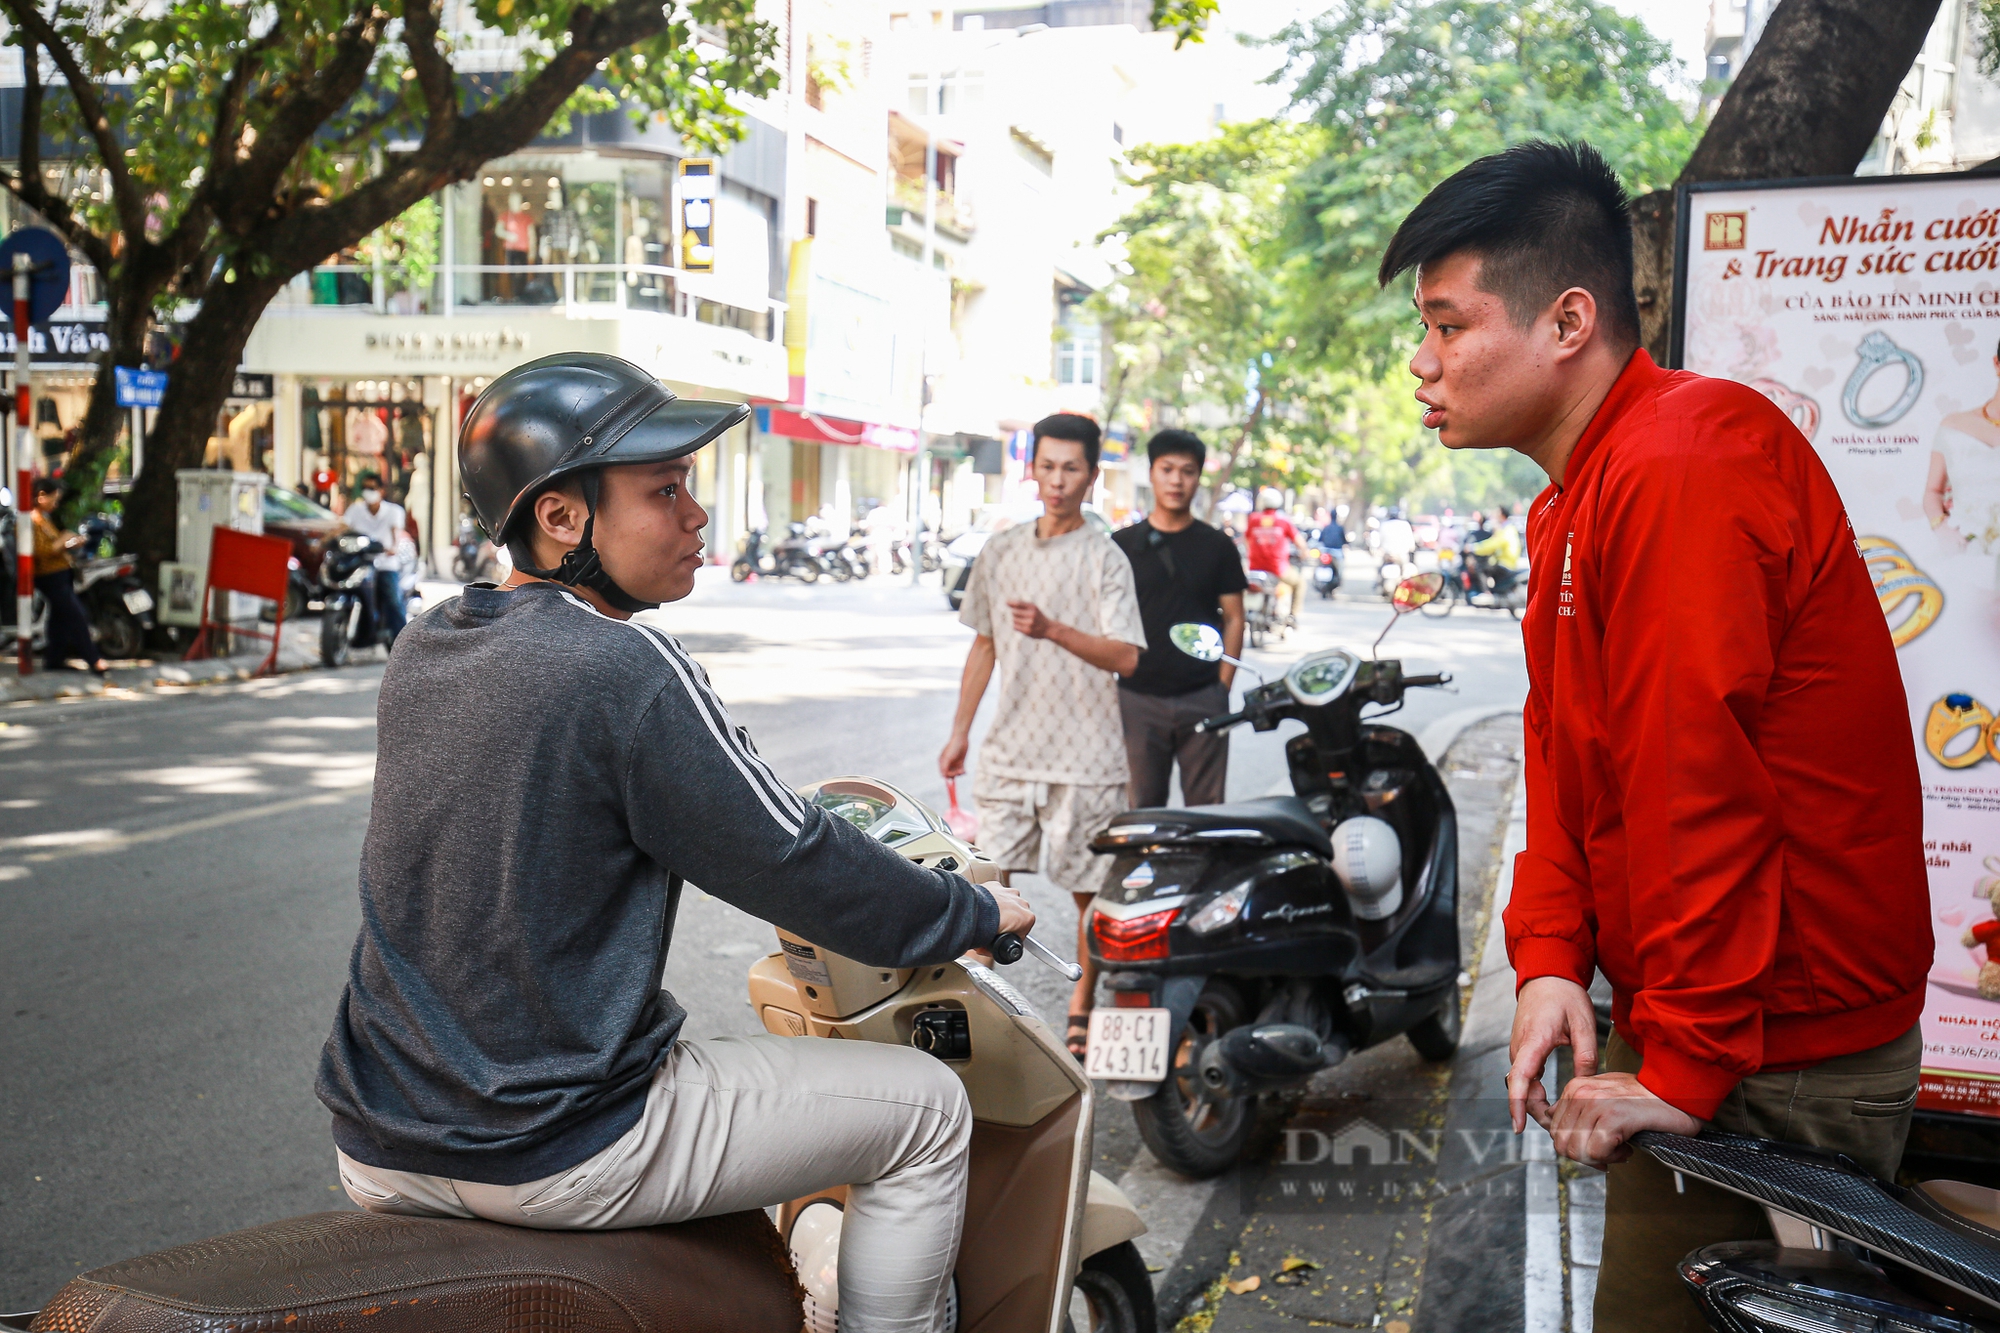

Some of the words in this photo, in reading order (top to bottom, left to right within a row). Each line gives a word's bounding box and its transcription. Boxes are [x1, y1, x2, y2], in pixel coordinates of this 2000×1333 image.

[1818, 207, 1915, 246] Nhẫn
[1924, 208, 2000, 242] cưới
[1721, 257, 1742, 280] &
[1755, 250, 1848, 283] Trang
[1857, 245, 1917, 275] sức
[1924, 241, 2000, 273] cưới
[1785, 291, 1824, 310] CỦA
[1831, 289, 1872, 309] BẢO
[1878, 288, 1911, 308] TÍN
[1918, 291, 1972, 306] MINH
[50, 323, 110, 353] Vân
[1941, 840, 1972, 853] nhất
[1091, 1046, 1160, 1075] 243.14
